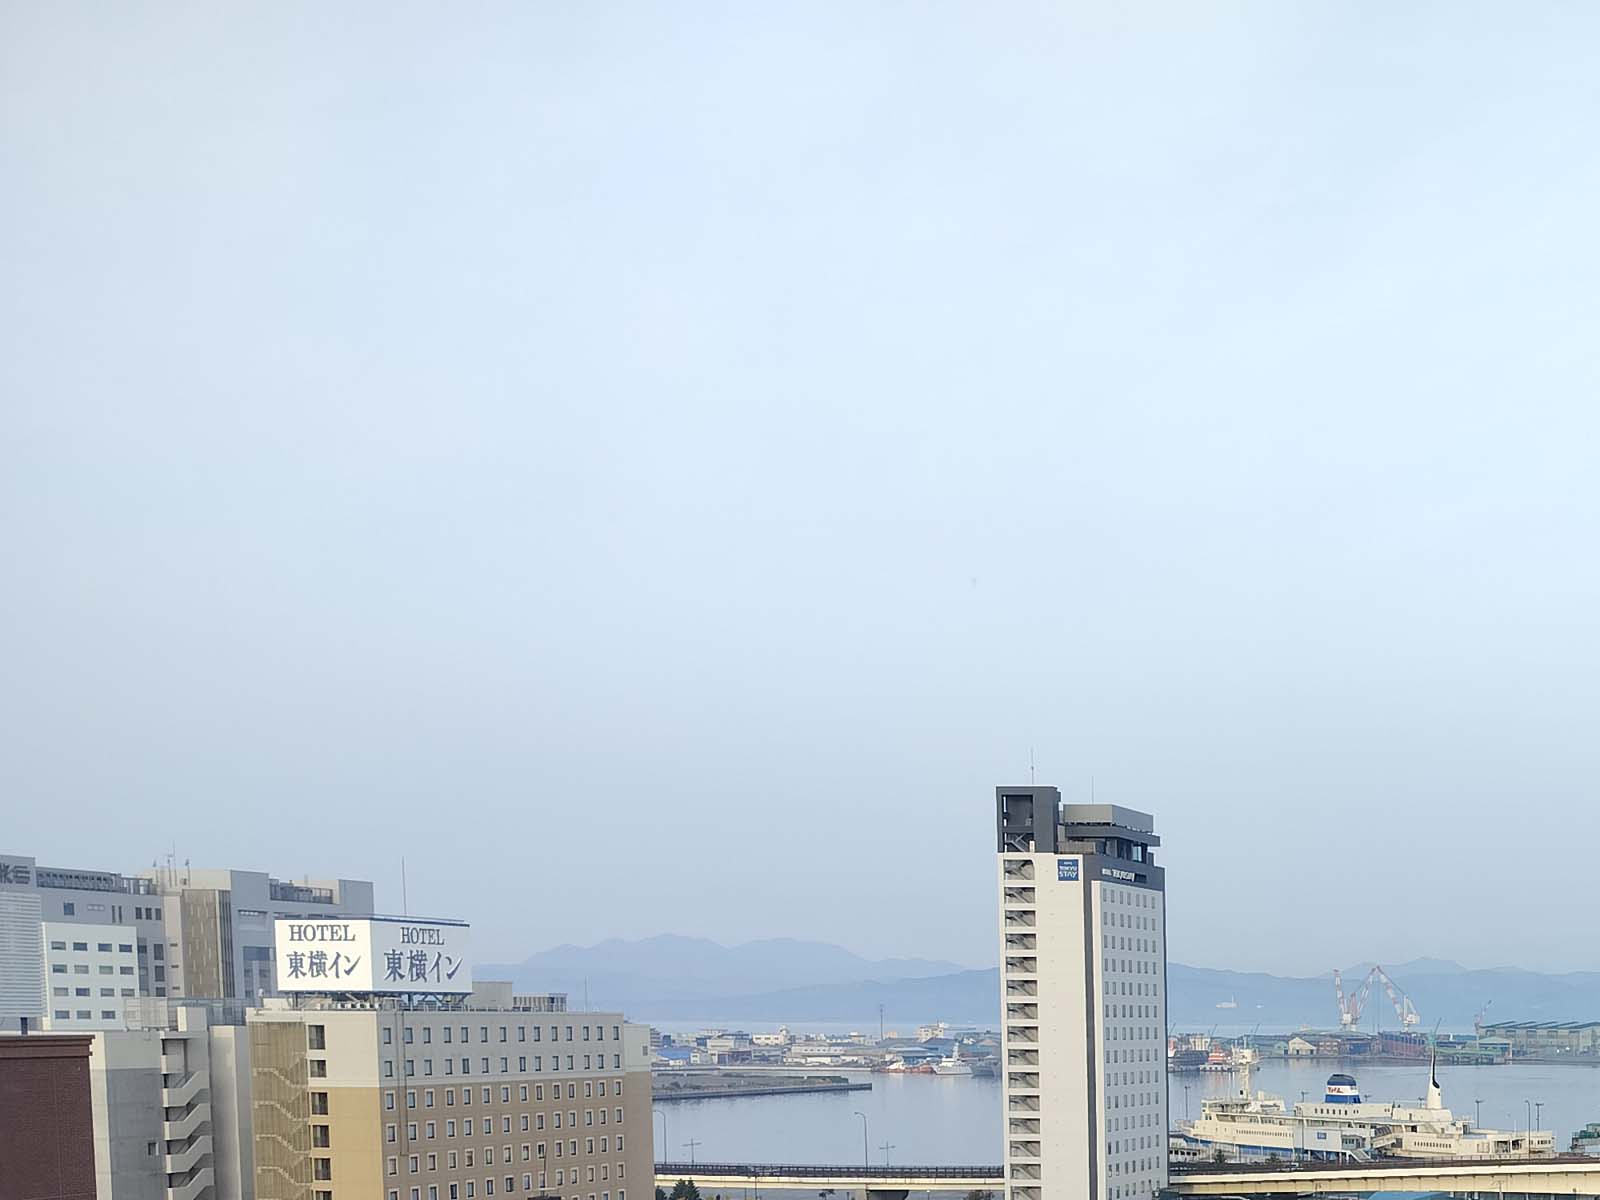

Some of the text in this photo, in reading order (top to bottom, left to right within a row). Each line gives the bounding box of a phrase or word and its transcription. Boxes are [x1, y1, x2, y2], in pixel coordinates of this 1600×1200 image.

[288, 924, 356, 942] HOTEL
[400, 926, 445, 946] HOTEL
[286, 950, 361, 979] 東横イン
[384, 949, 463, 983] 東横イン
